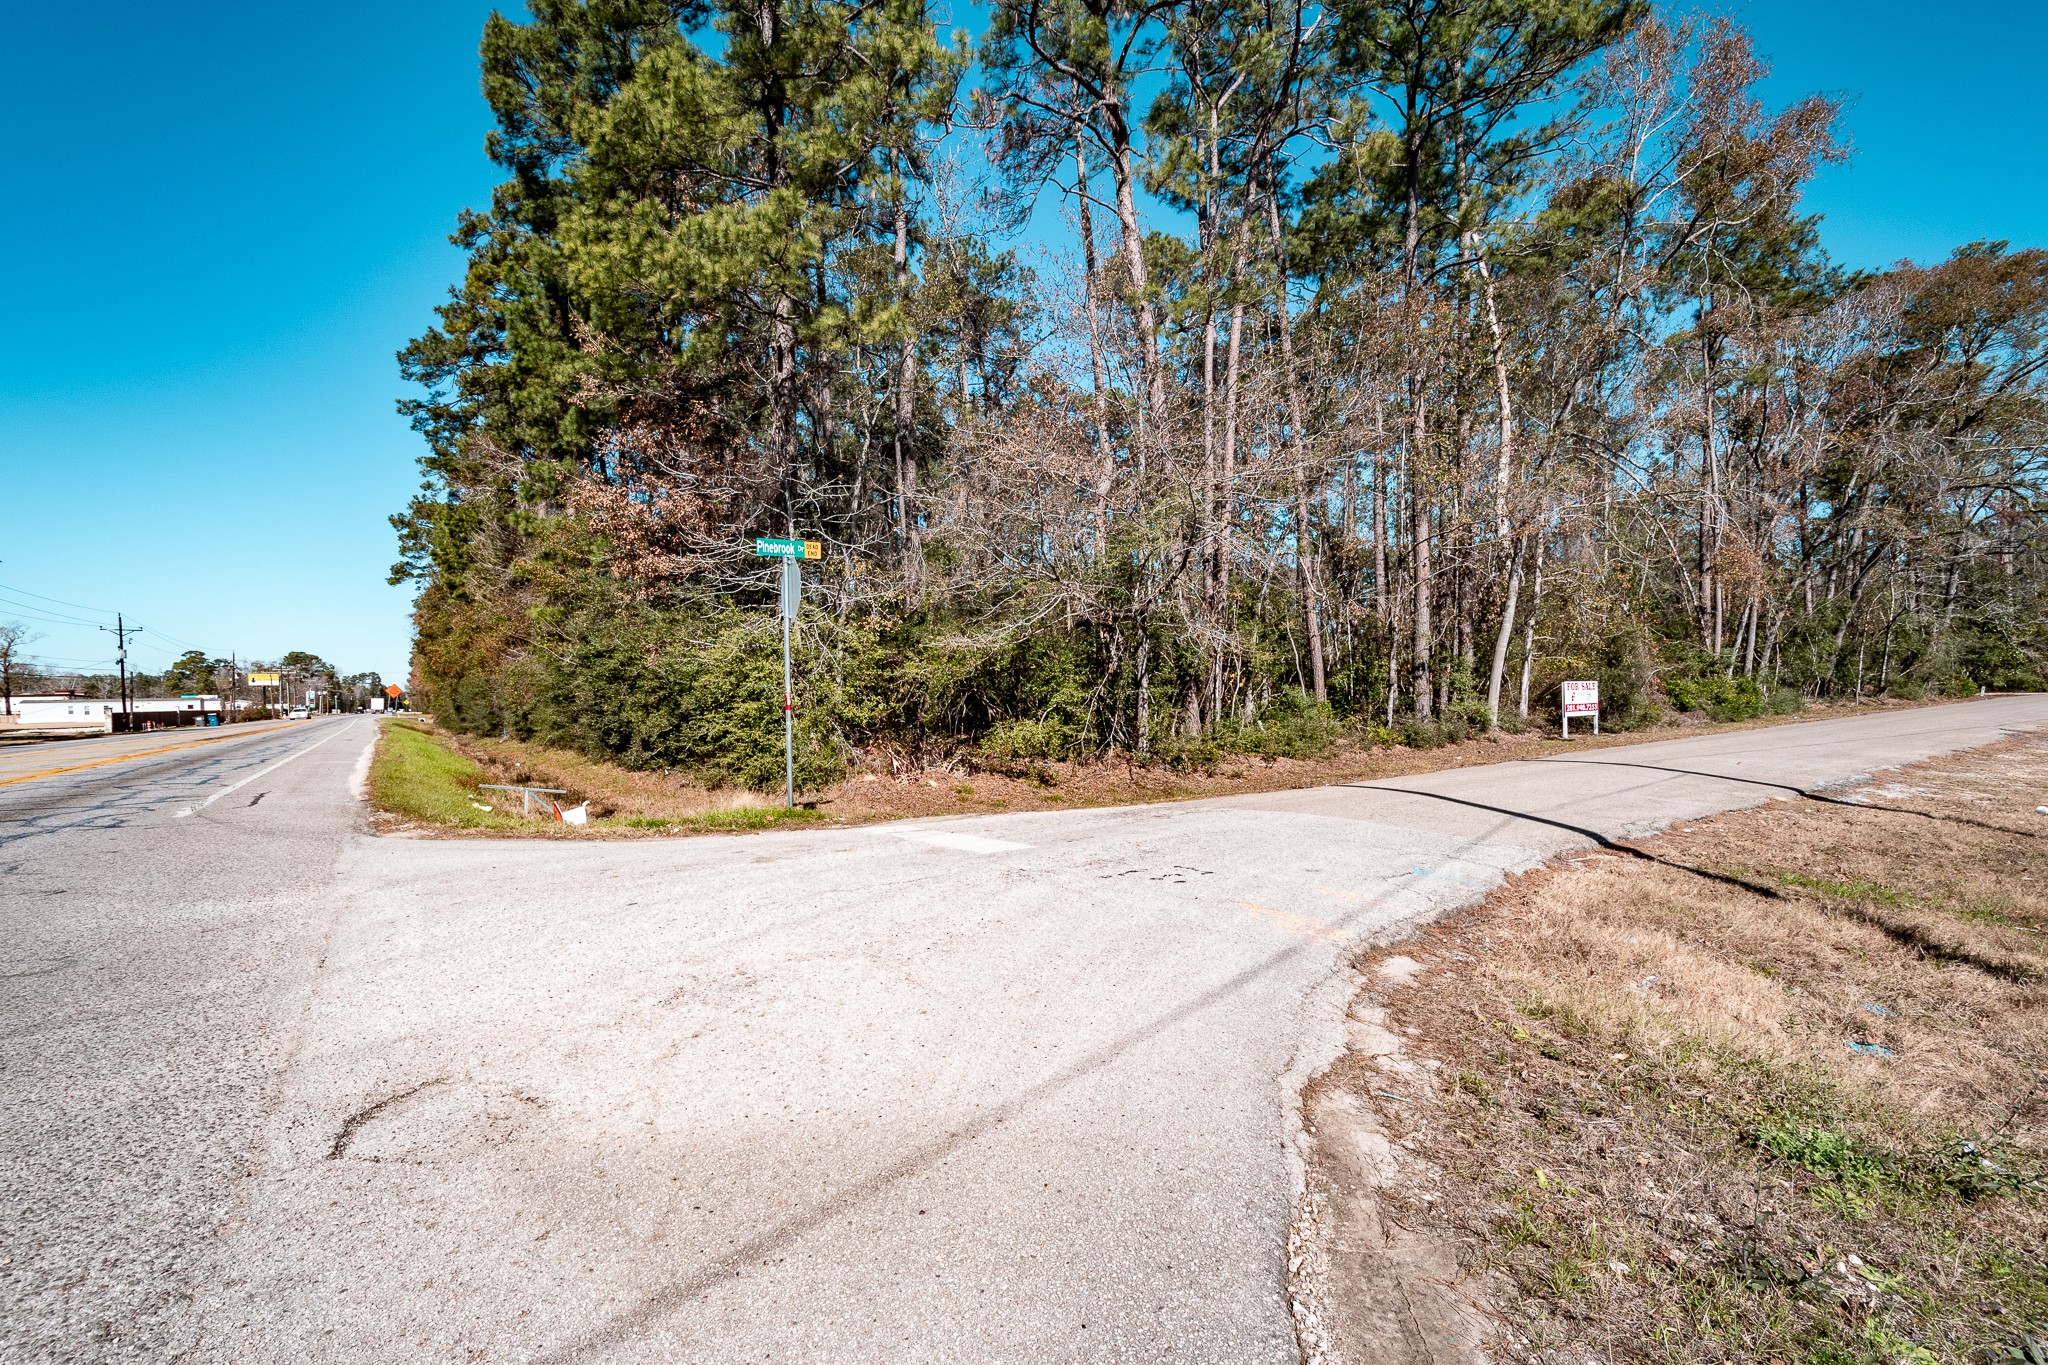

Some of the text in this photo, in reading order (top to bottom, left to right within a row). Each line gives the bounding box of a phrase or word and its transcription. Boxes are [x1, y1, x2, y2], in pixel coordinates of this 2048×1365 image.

[757, 540, 795, 554] Pinebrook
[1567, 682, 1596, 690] FOR SALE
